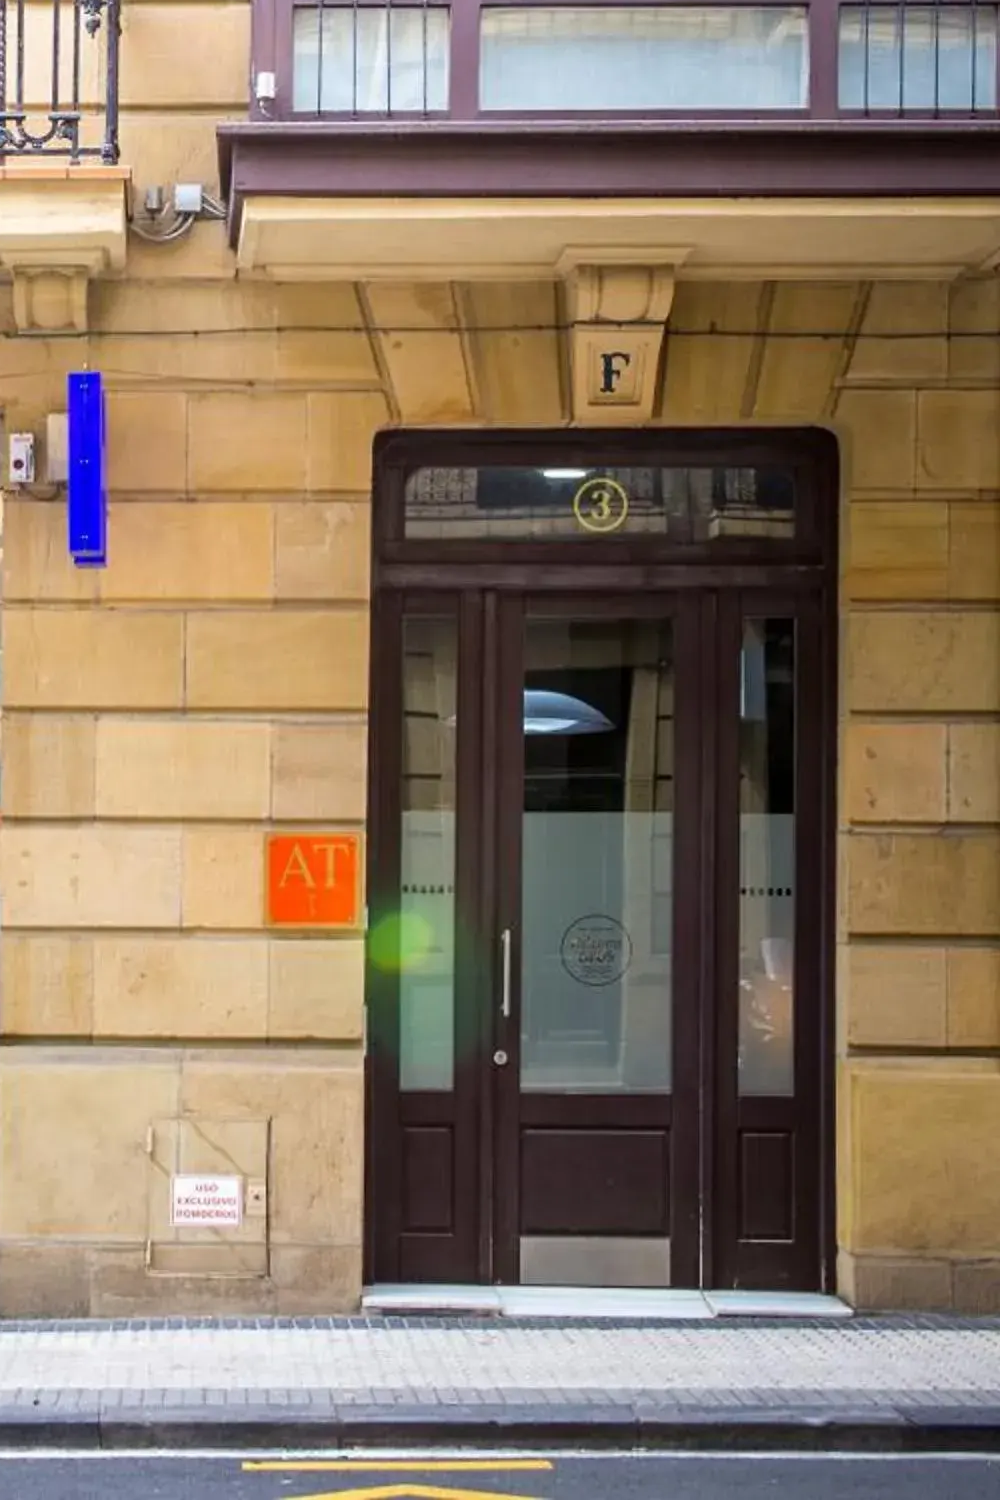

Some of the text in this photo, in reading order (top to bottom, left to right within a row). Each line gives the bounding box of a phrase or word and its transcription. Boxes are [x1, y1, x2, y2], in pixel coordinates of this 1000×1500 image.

[600, 352, 630, 393] F
[591, 489, 611, 521] 3
[279, 842, 350, 889] AT
